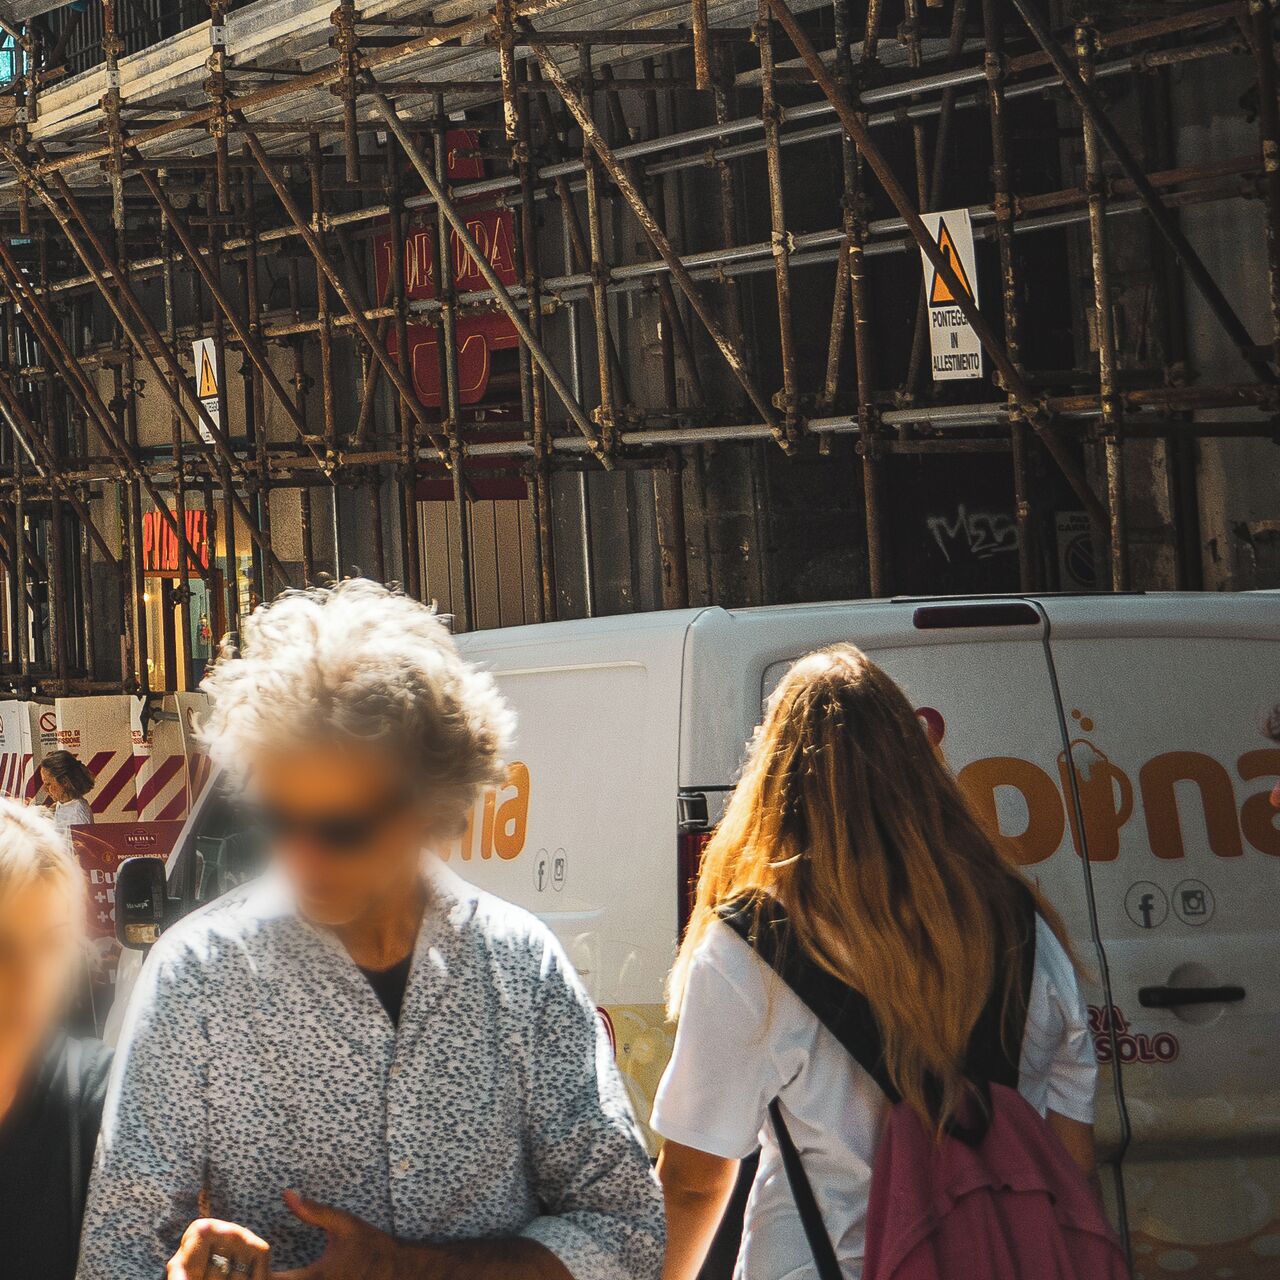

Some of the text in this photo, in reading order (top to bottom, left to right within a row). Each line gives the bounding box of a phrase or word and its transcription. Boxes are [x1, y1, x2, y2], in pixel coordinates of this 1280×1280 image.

[932, 309, 969, 328] PONTEGG
[950, 332, 958, 348] IN
[934, 353, 980, 371] ALLESTIMENTO
[1095, 1031, 1180, 1063] SOLO
